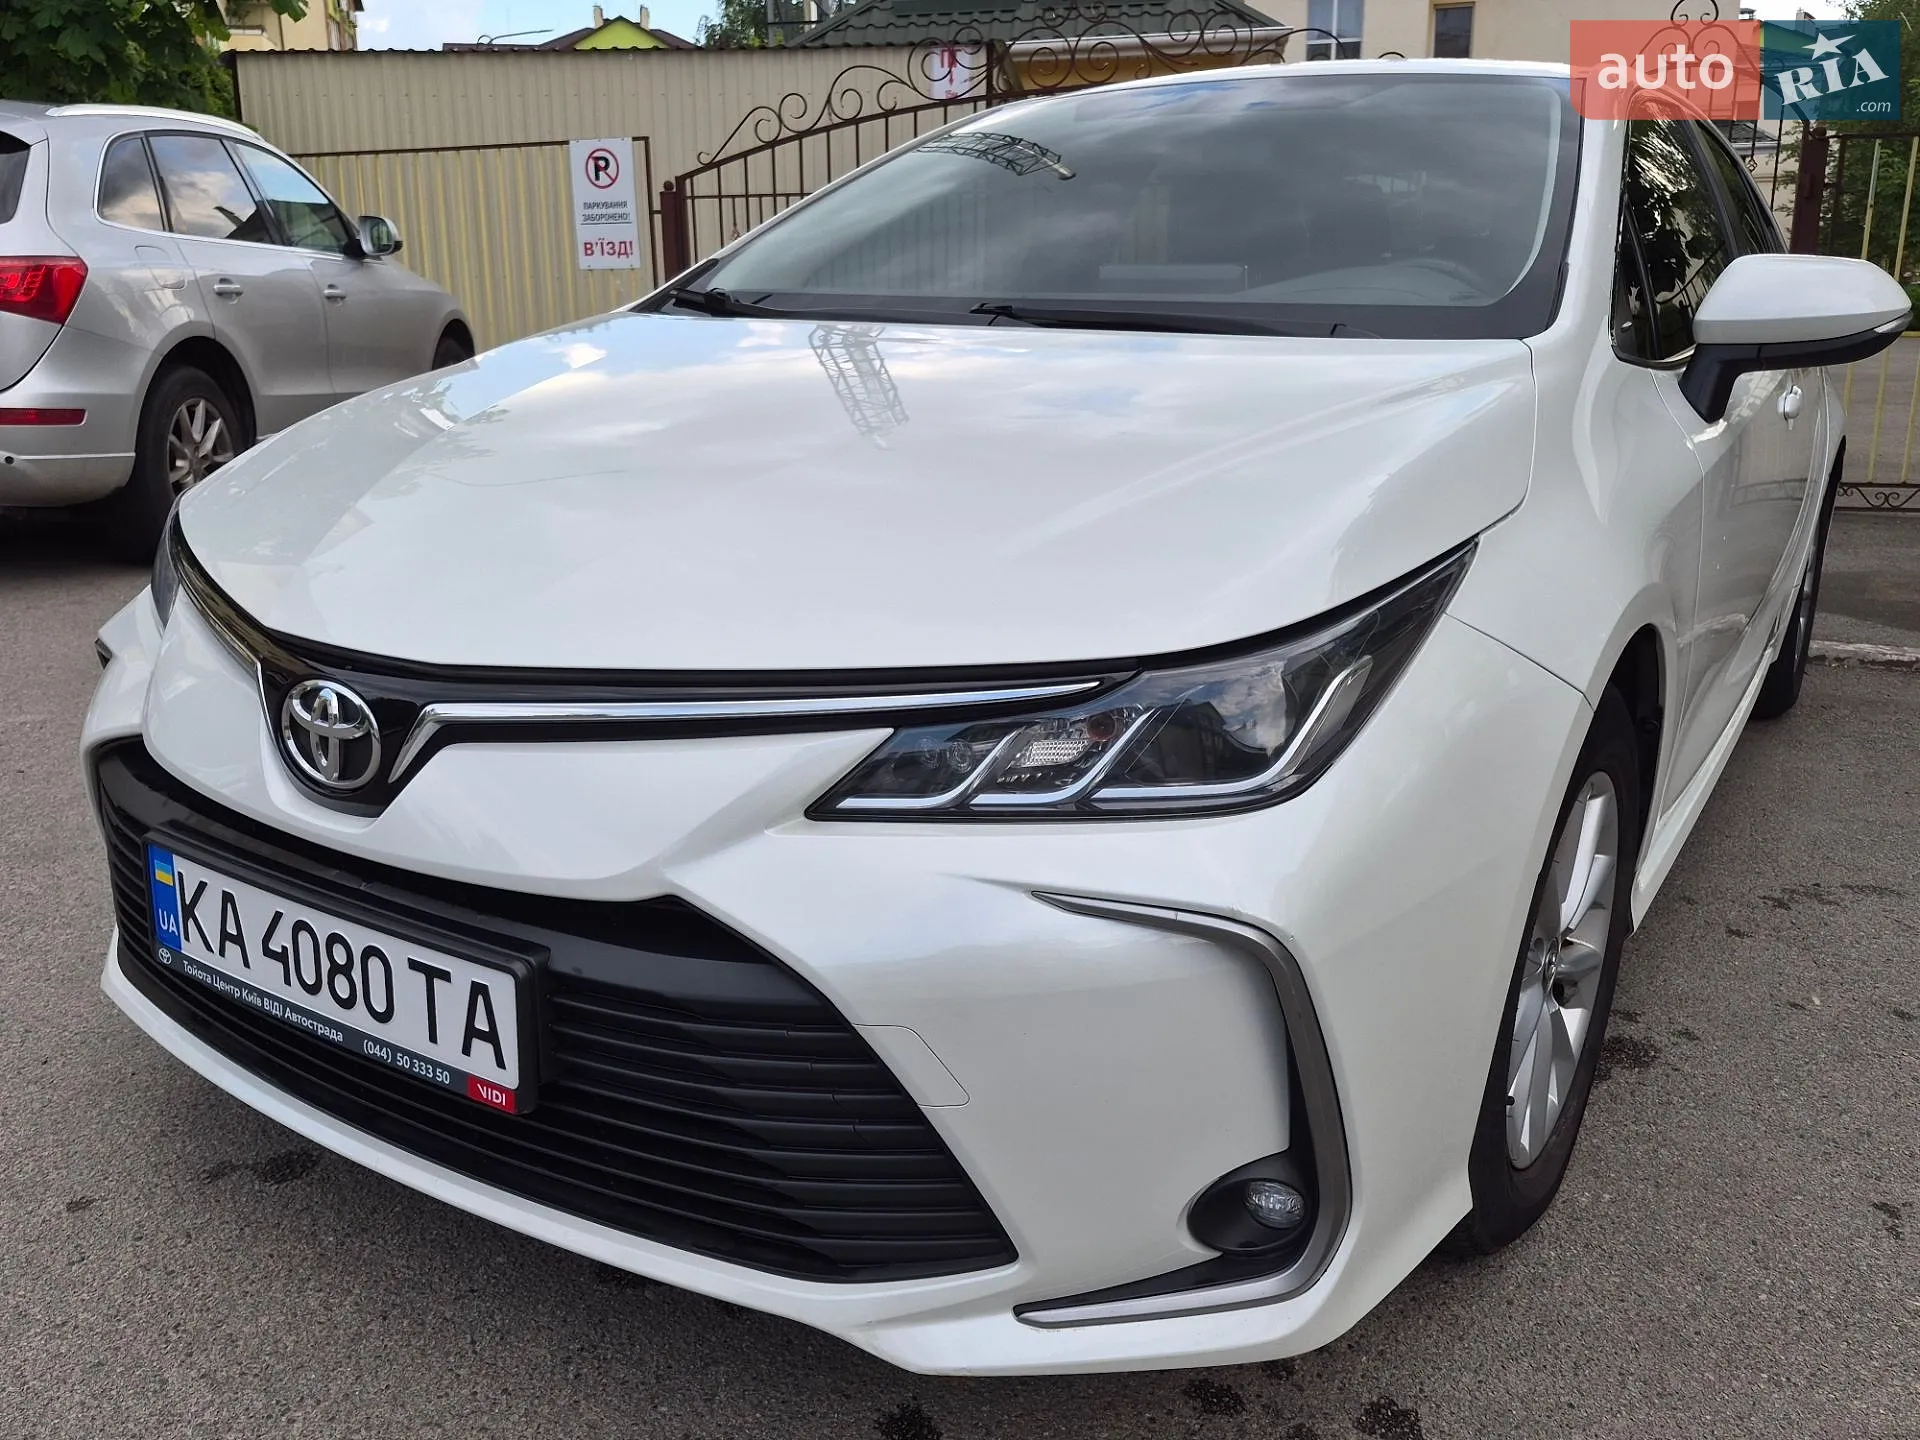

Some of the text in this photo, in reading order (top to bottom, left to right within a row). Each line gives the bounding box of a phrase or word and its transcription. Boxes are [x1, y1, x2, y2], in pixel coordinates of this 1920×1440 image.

[583, 201, 628, 210] ПАРКУВАННЯ
[159, 908, 179, 937] UA
[261, 910, 395, 1025] 4080
[183, 960, 212, 983] Тойота
[213, 974, 240, 998] Центр
[242, 987, 262, 1007] Київ
[284, 1007, 343, 1042] Автострада
[363, 1039, 450, 1084] (044) 50 333 50
[477, 1083, 506, 1106] VIDI
